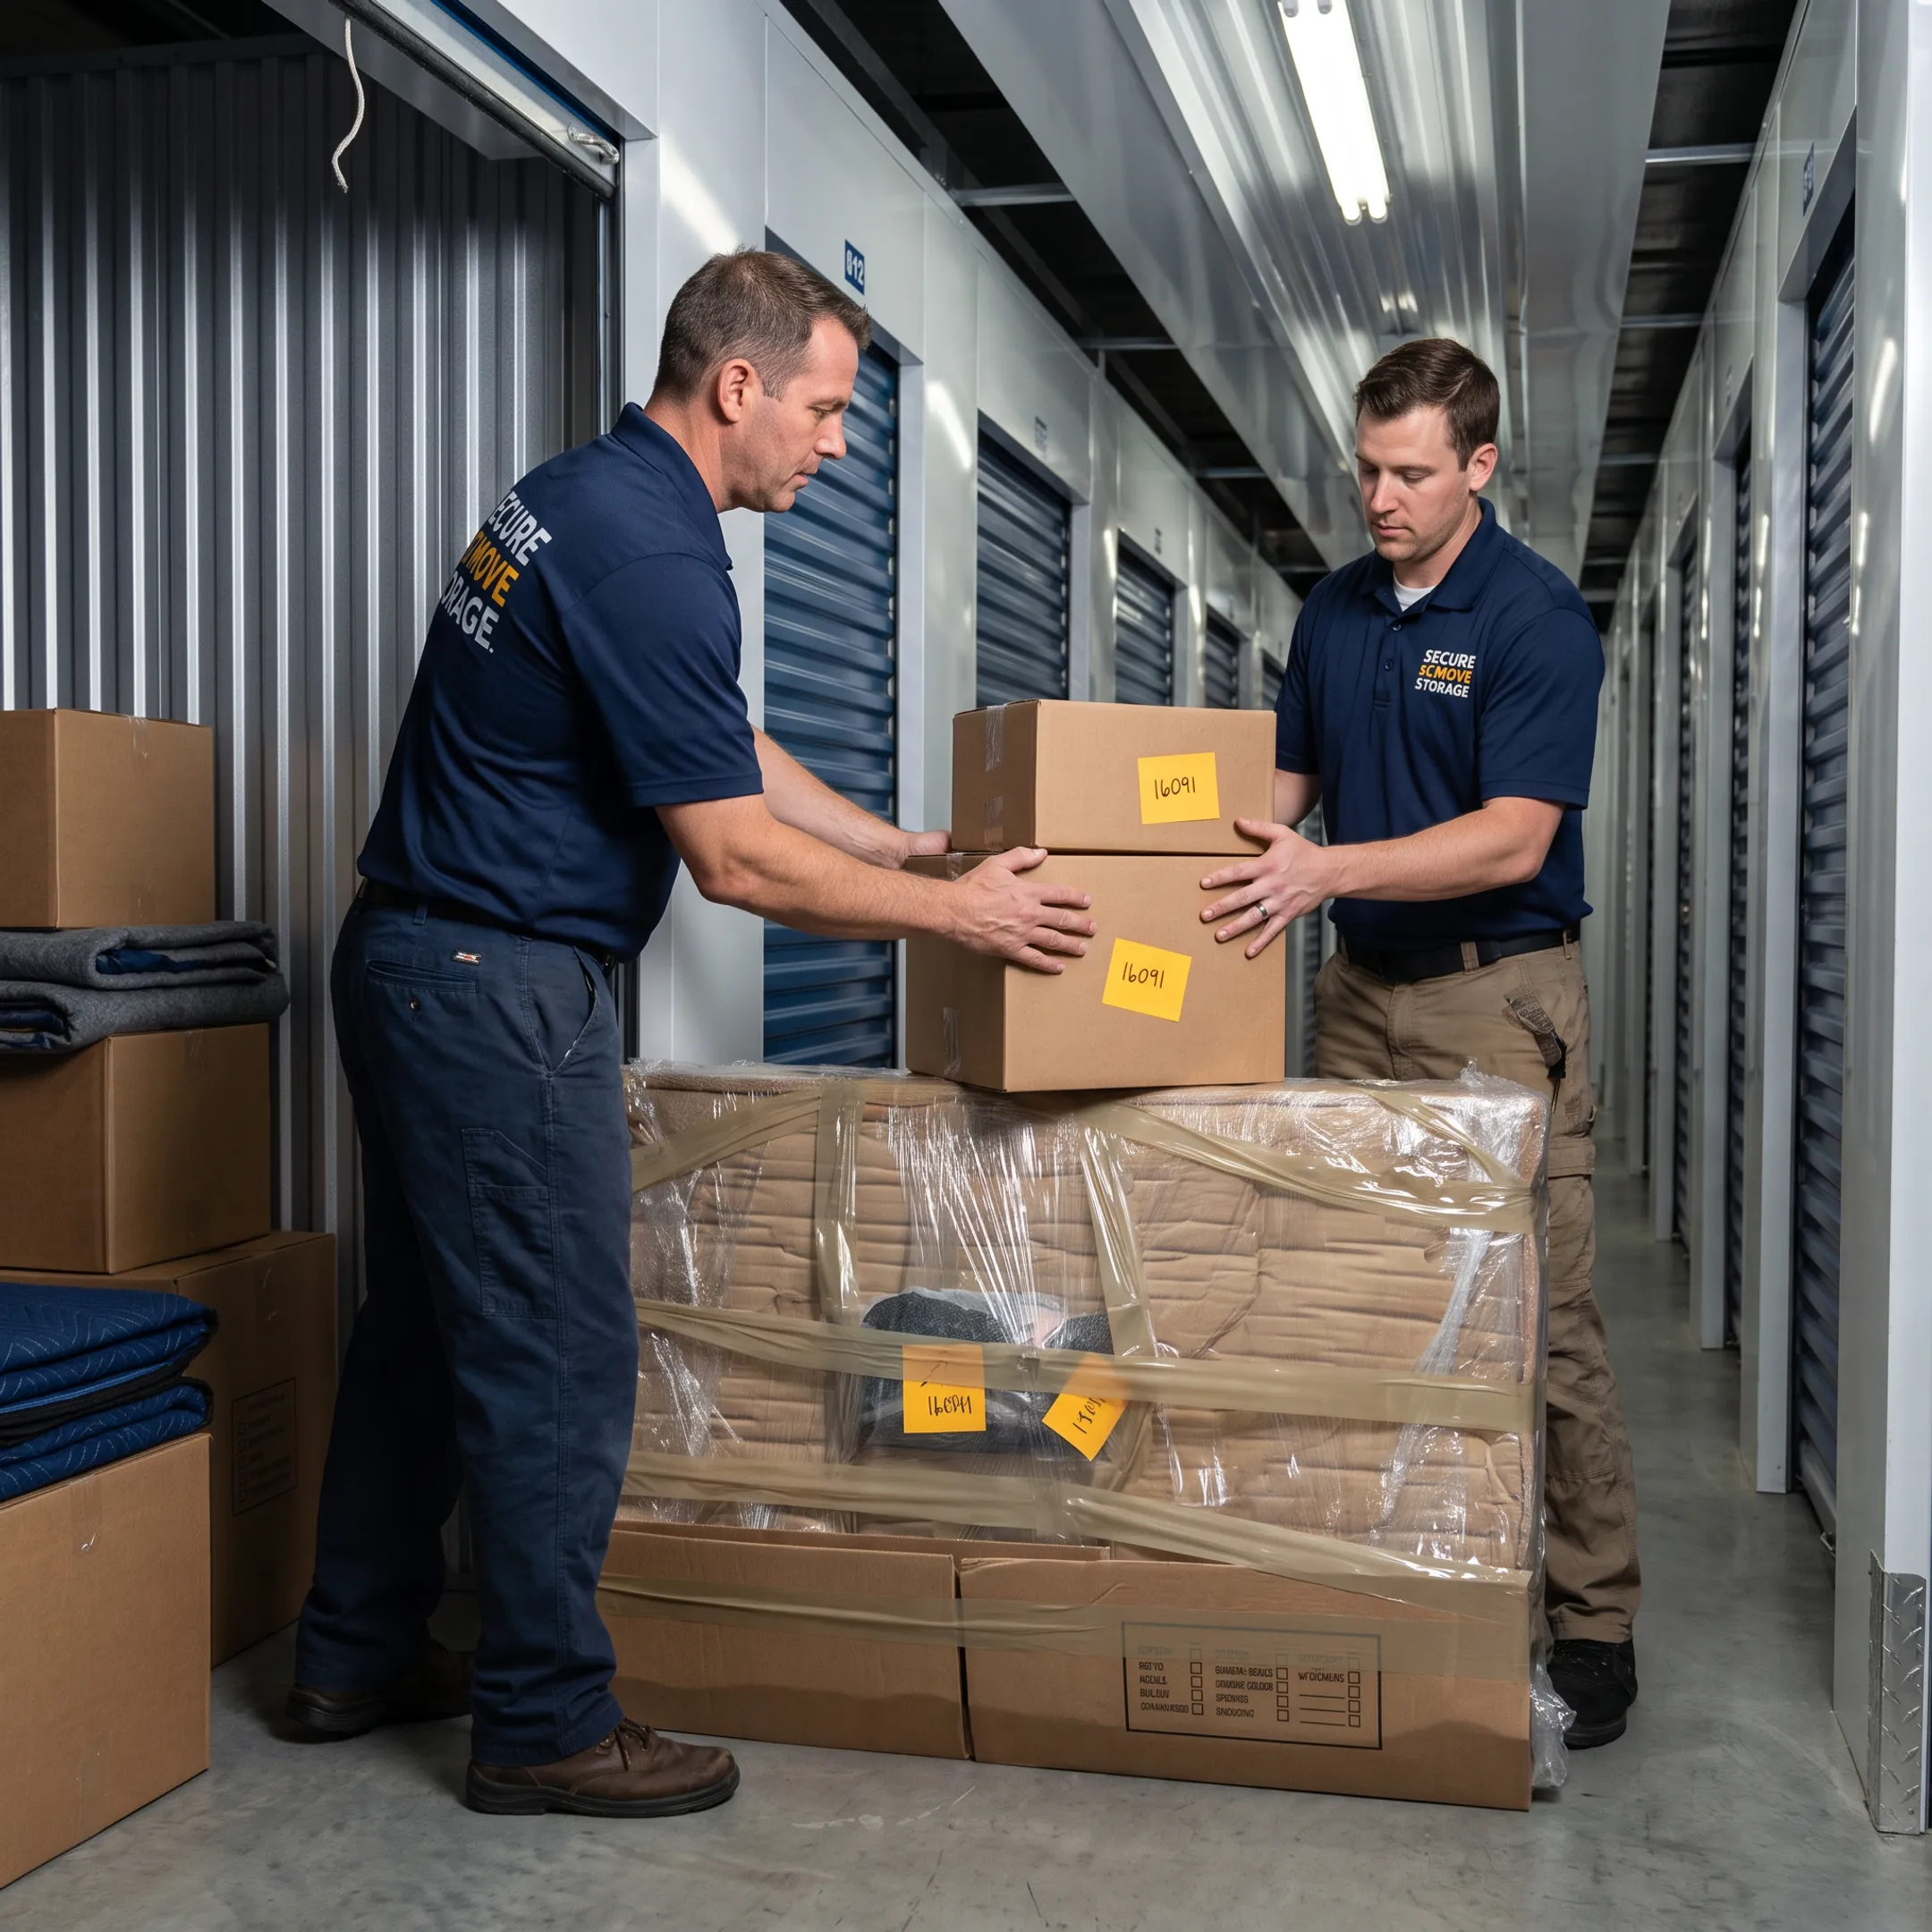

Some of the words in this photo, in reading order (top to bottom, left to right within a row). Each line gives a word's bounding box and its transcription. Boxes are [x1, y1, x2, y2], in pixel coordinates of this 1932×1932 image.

[1423, 648, 1477, 669] SECURE
[1414, 677, 1470, 698] STORAGE
[1154, 776, 1196, 800] 16091
[1122, 962, 1165, 988] 16091
